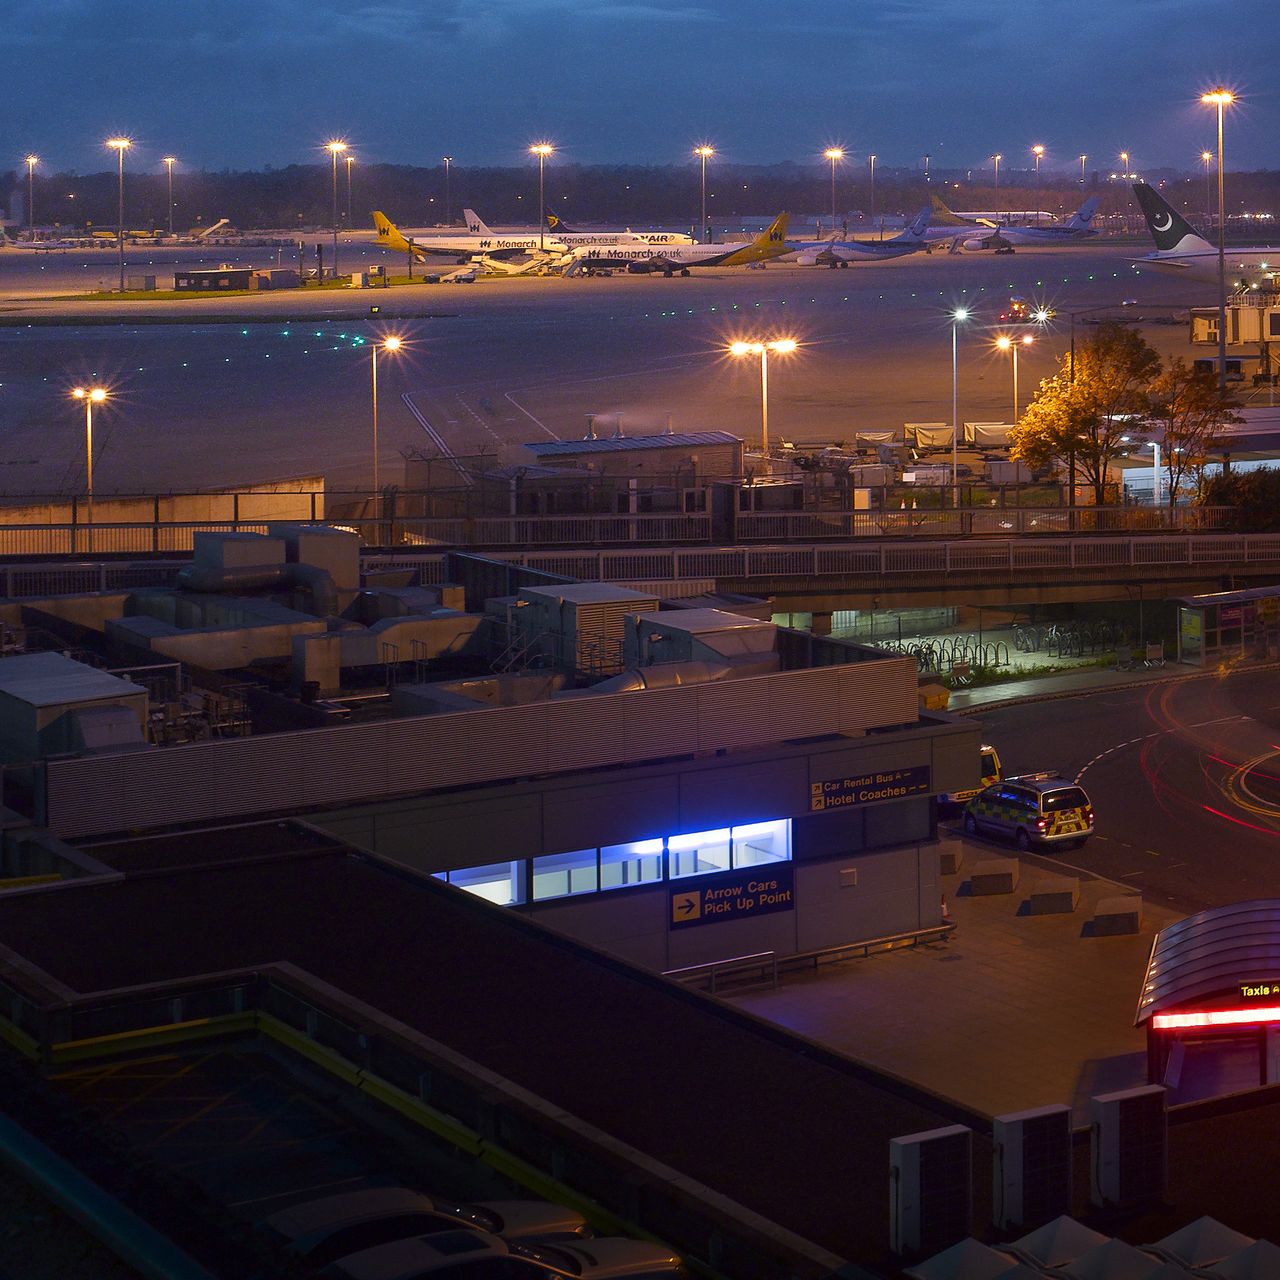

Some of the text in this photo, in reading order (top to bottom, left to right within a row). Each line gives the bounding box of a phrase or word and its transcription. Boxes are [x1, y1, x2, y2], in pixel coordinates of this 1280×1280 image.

[497, 240, 537, 248] Monarch
[824, 782, 840, 791] Car
[844, 776, 873, 788] Rental
[876, 774, 893, 784] Bus
[826, 786, 907, 806] Hotel Coaches
[705, 880, 777, 900] Arrow Cars
[705, 890, 791, 915] Pick Up Point
[1241, 985, 1270, 996] Taxis
